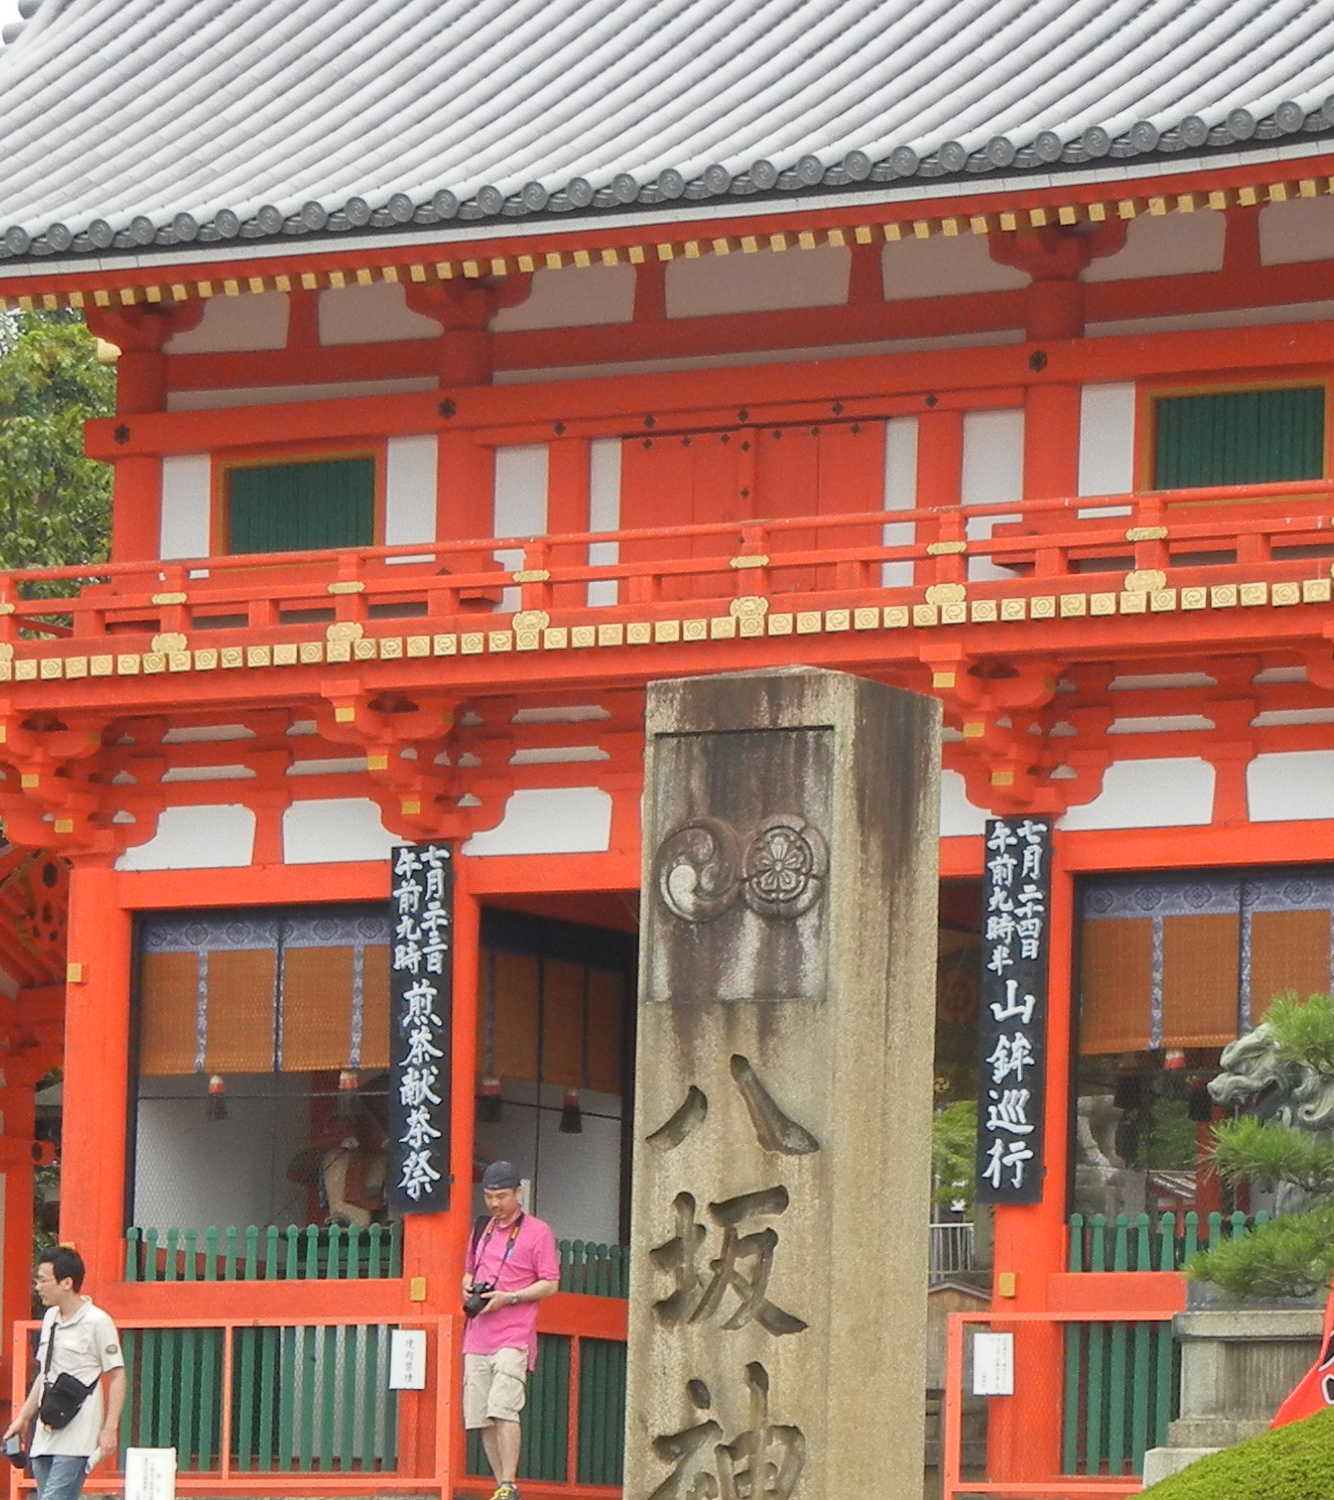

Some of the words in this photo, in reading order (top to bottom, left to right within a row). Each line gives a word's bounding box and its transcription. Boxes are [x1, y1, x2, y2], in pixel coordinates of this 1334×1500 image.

[393, 848, 423, 974] 午前九時
[419, 845, 450, 975] 七月二十三日
[987, 822, 1018, 976] 午前九時半
[1014, 819, 1047, 960] 七月二十四日
[398, 978, 443, 1201] 煎茶献茶祭
[982, 980, 1036, 1188] 山鉾巡行
